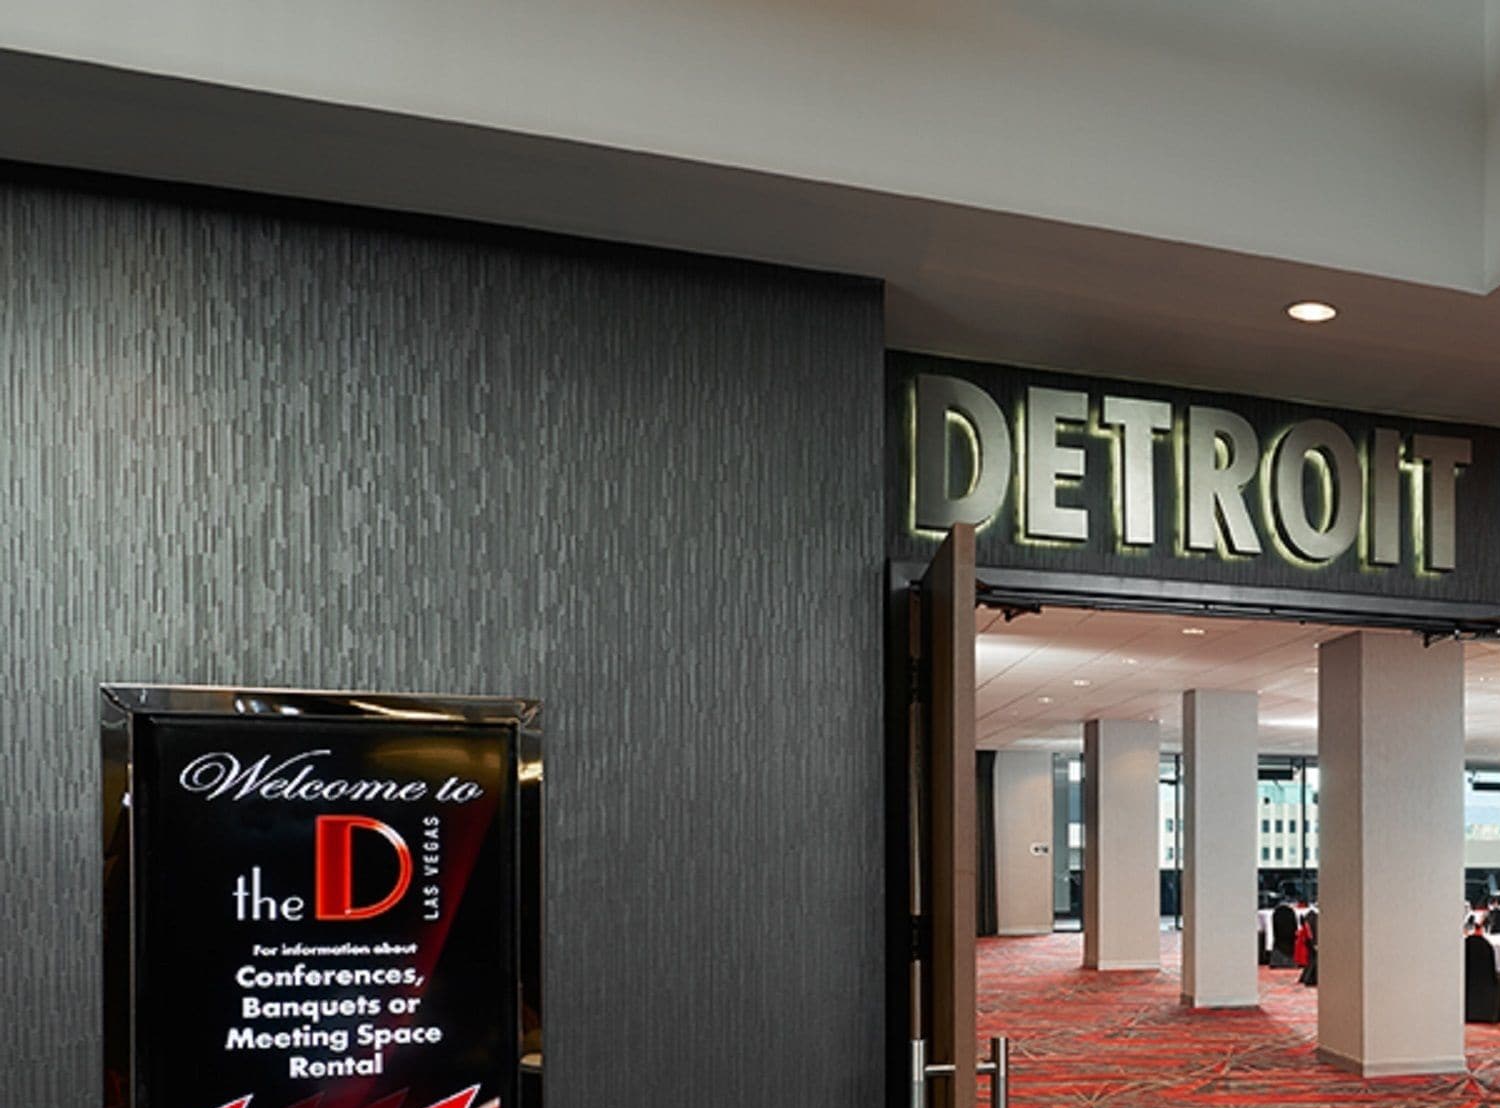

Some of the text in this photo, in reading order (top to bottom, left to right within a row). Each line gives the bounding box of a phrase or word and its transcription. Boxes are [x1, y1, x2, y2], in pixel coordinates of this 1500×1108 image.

[910, 373, 1473, 572] DETROIT
[179, 750, 484, 802] Welcome to
[232, 814, 413, 921] the D
[423, 815, 440, 920] LAS VEGAS
[253, 942, 417, 956] For information about
[236, 964, 424, 988] Conferences,
[242, 996, 421, 1022] Banquets or
[225, 1023, 443, 1052] Meeting Space
[289, 1052, 383, 1078] Rental
